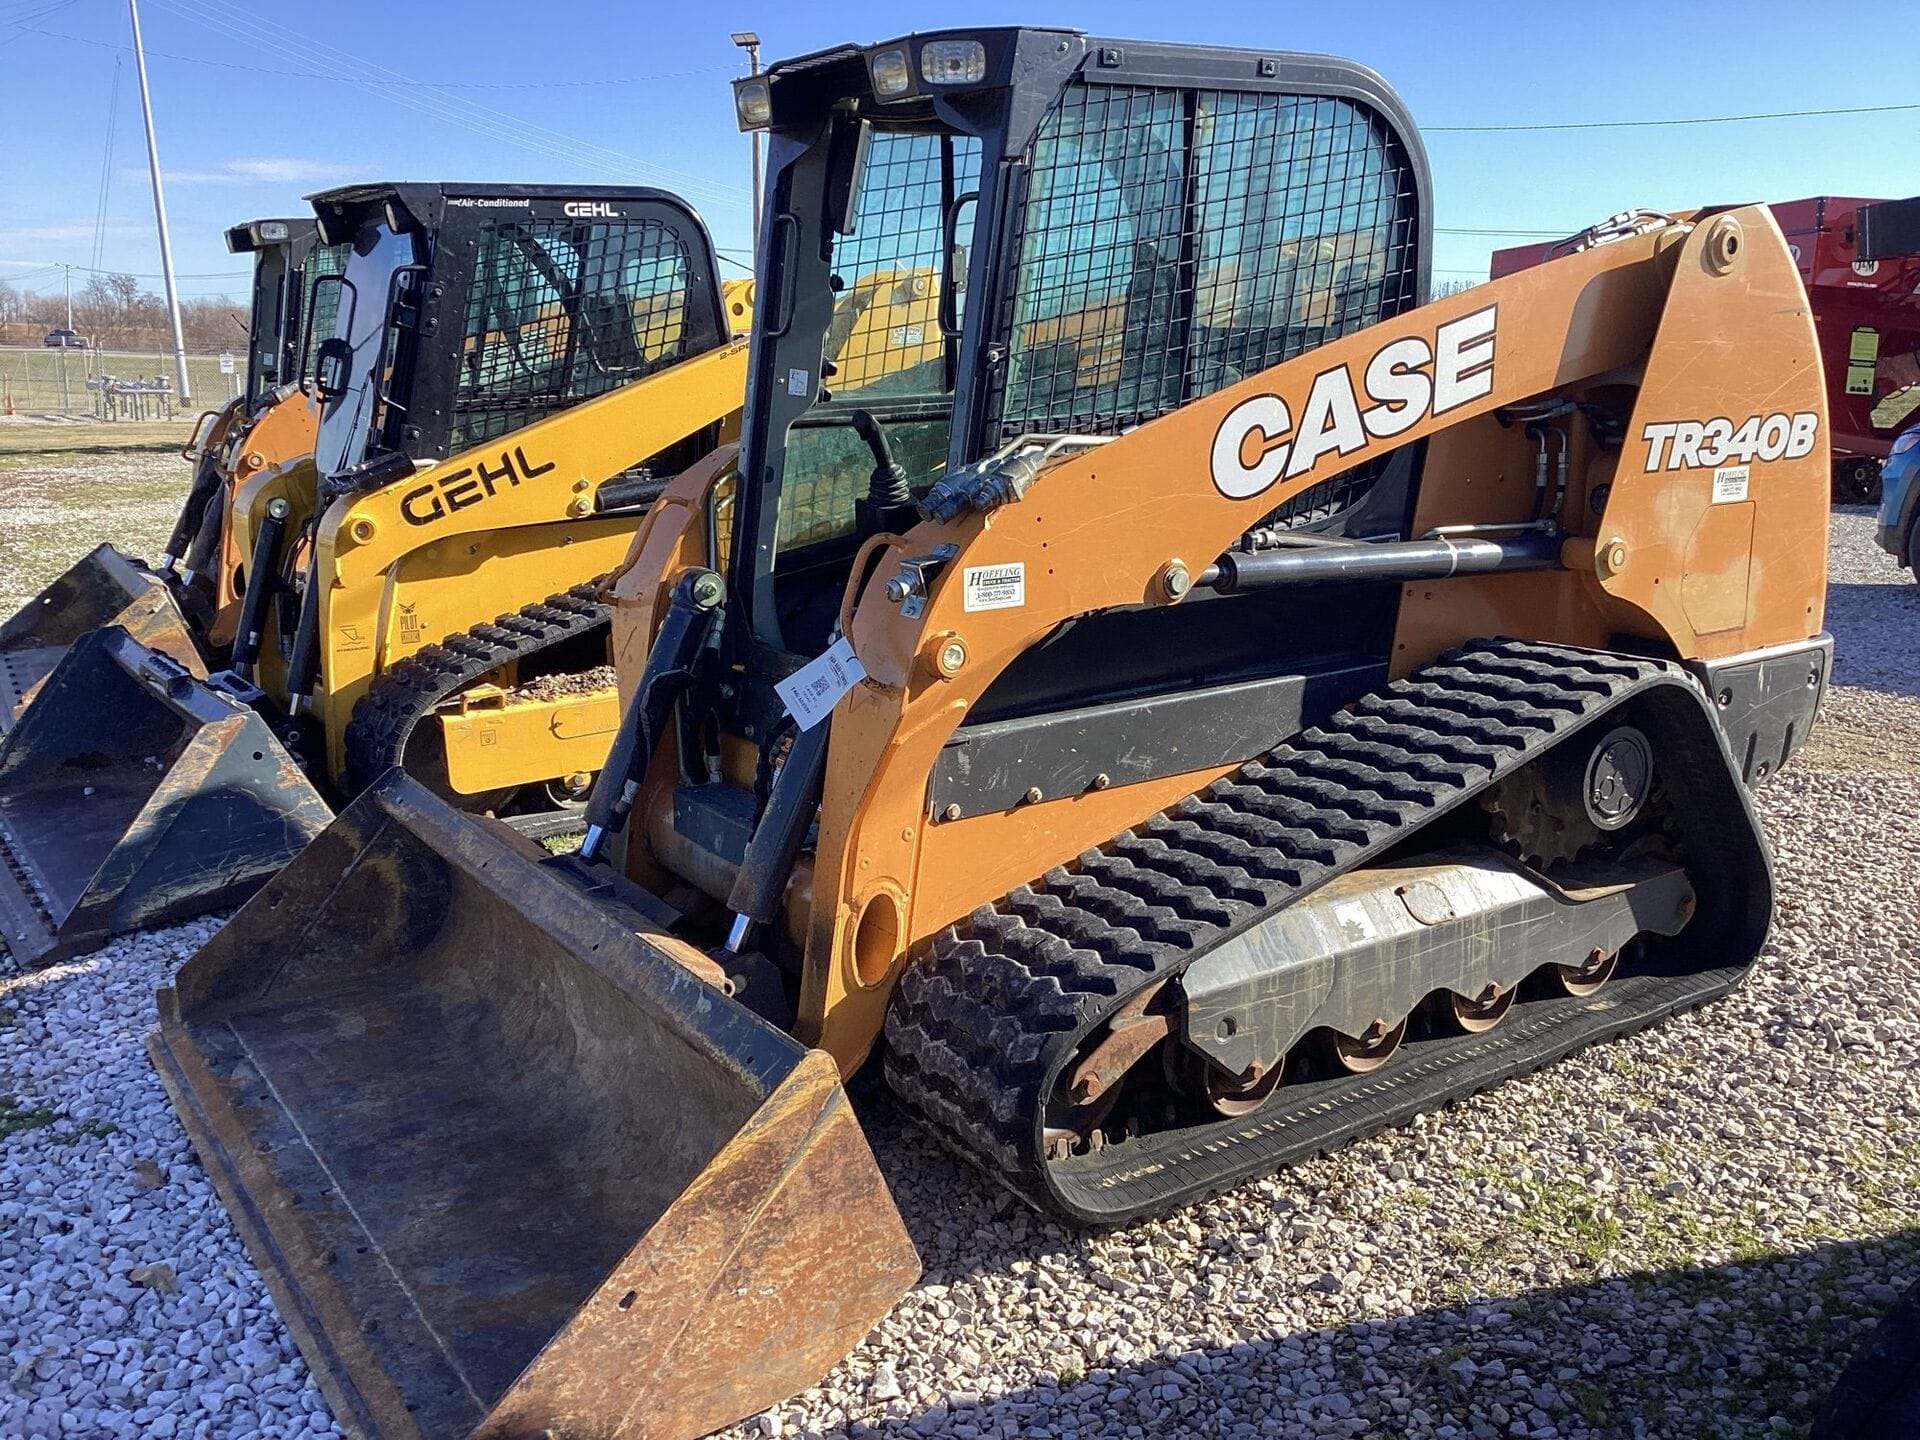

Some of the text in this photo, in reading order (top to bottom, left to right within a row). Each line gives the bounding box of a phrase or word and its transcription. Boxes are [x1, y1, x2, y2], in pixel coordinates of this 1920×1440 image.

[462, 198, 530, 208] Air-Conditioned
[564, 202, 619, 217] GEHL
[1210, 302, 1498, 500] CASE
[1642, 411, 1820, 473] TR340B
[400, 445, 556, 526] GEHL
[968, 568, 1020, 586] HOEFLING
[400, 614, 417, 630] PILOT
